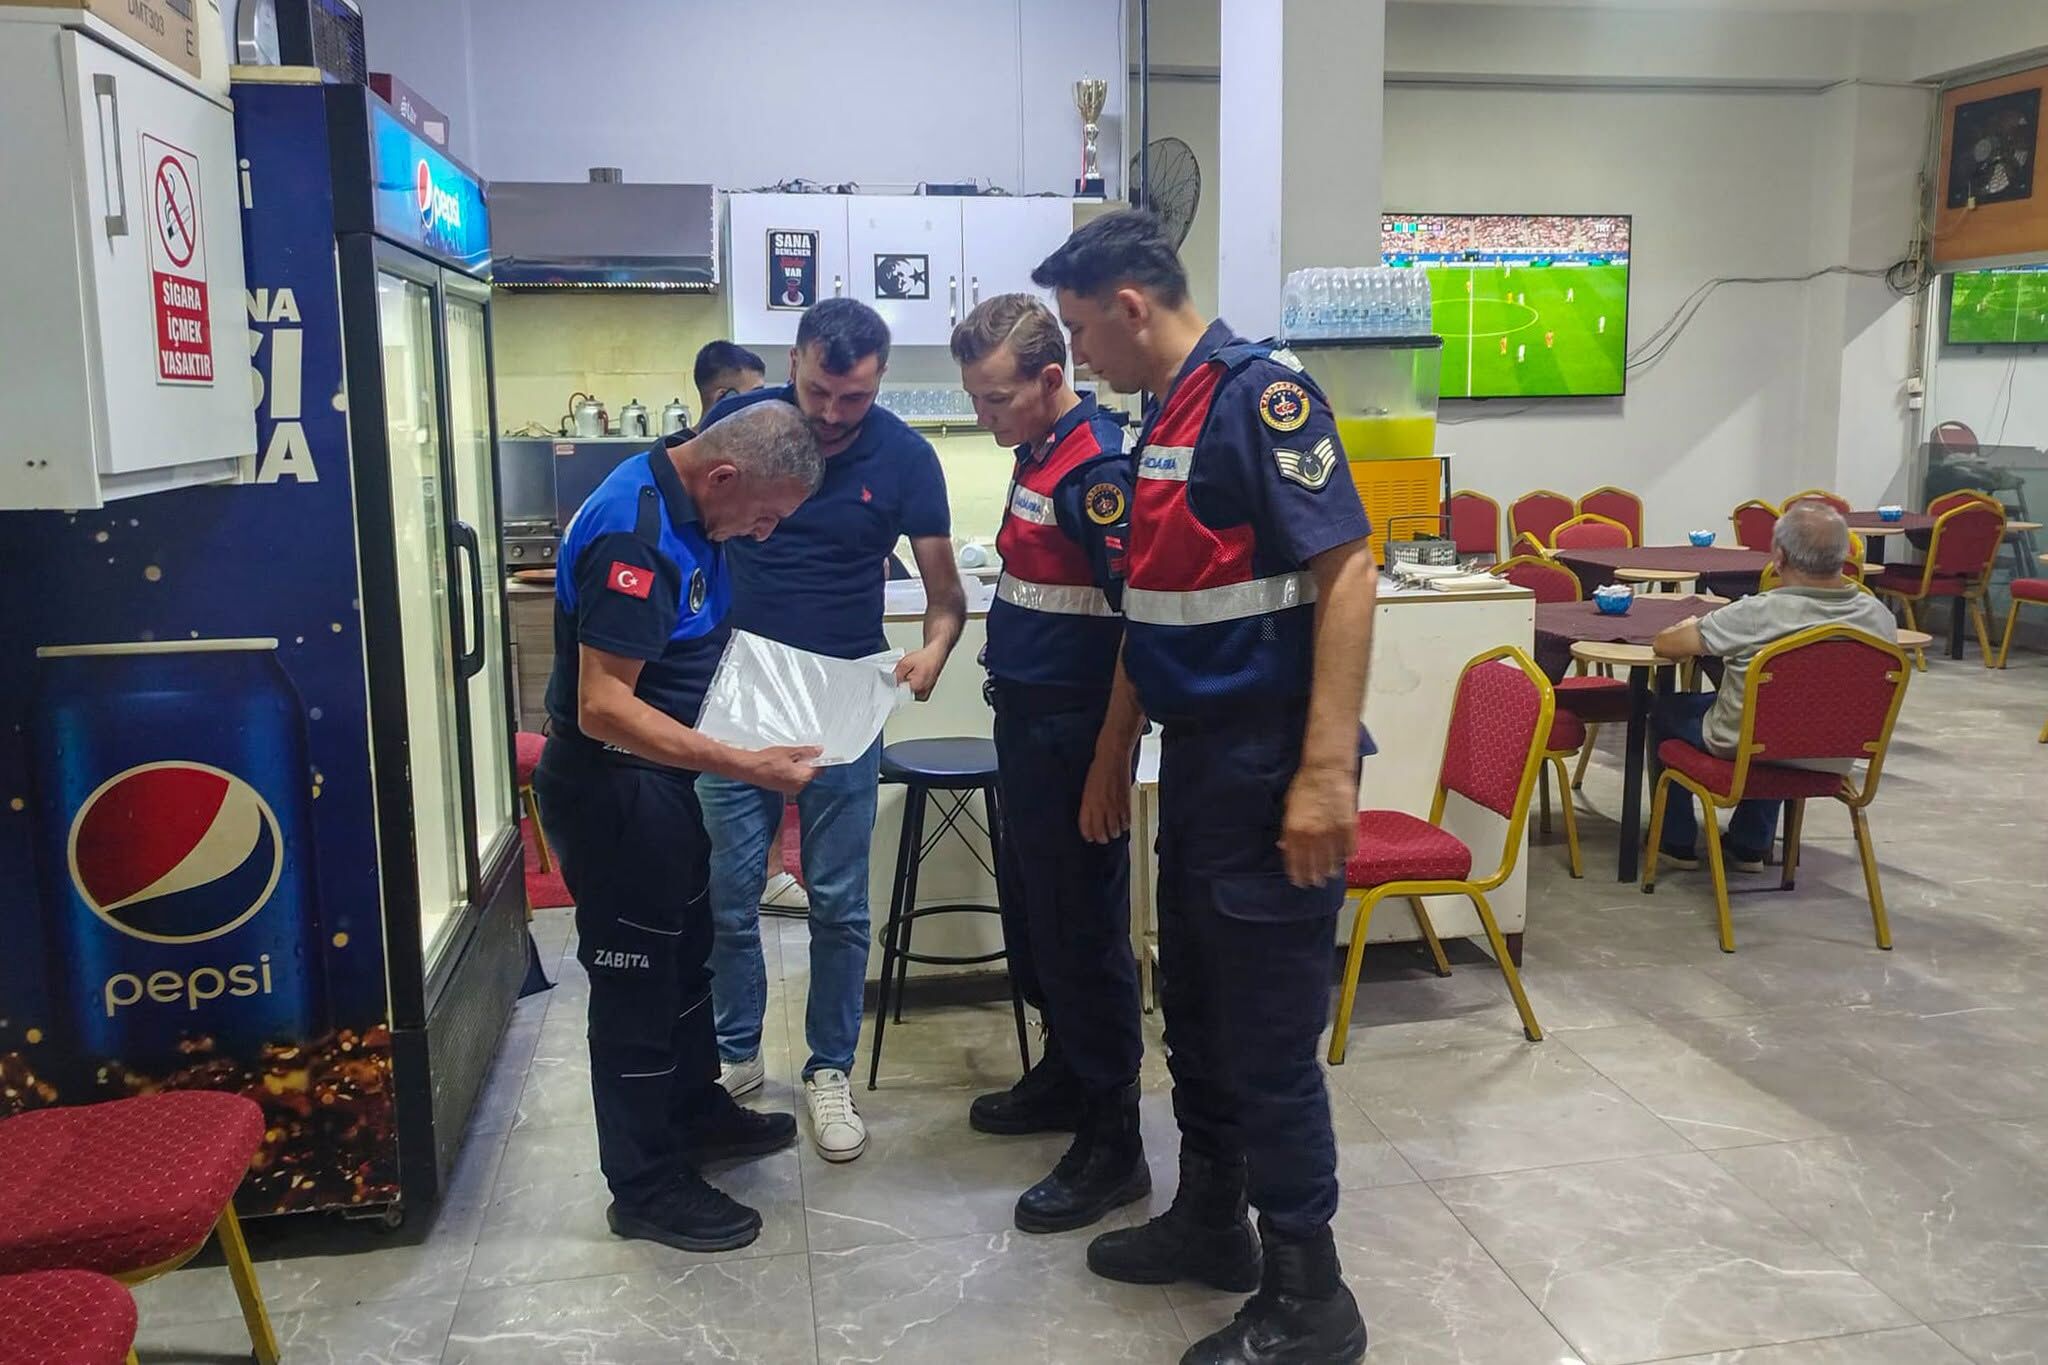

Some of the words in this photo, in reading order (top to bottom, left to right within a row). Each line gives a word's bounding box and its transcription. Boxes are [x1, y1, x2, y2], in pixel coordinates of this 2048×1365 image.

[774, 233, 812, 248] SANA
[784, 267, 802, 277] VAR
[162, 277, 202, 312] SİGARA
[167, 311, 203, 347] İÇMEK
[161, 349, 212, 377] YASAKTIR
[593, 949, 650, 969] ZABITA
[104, 953, 273, 1018] pepsi
